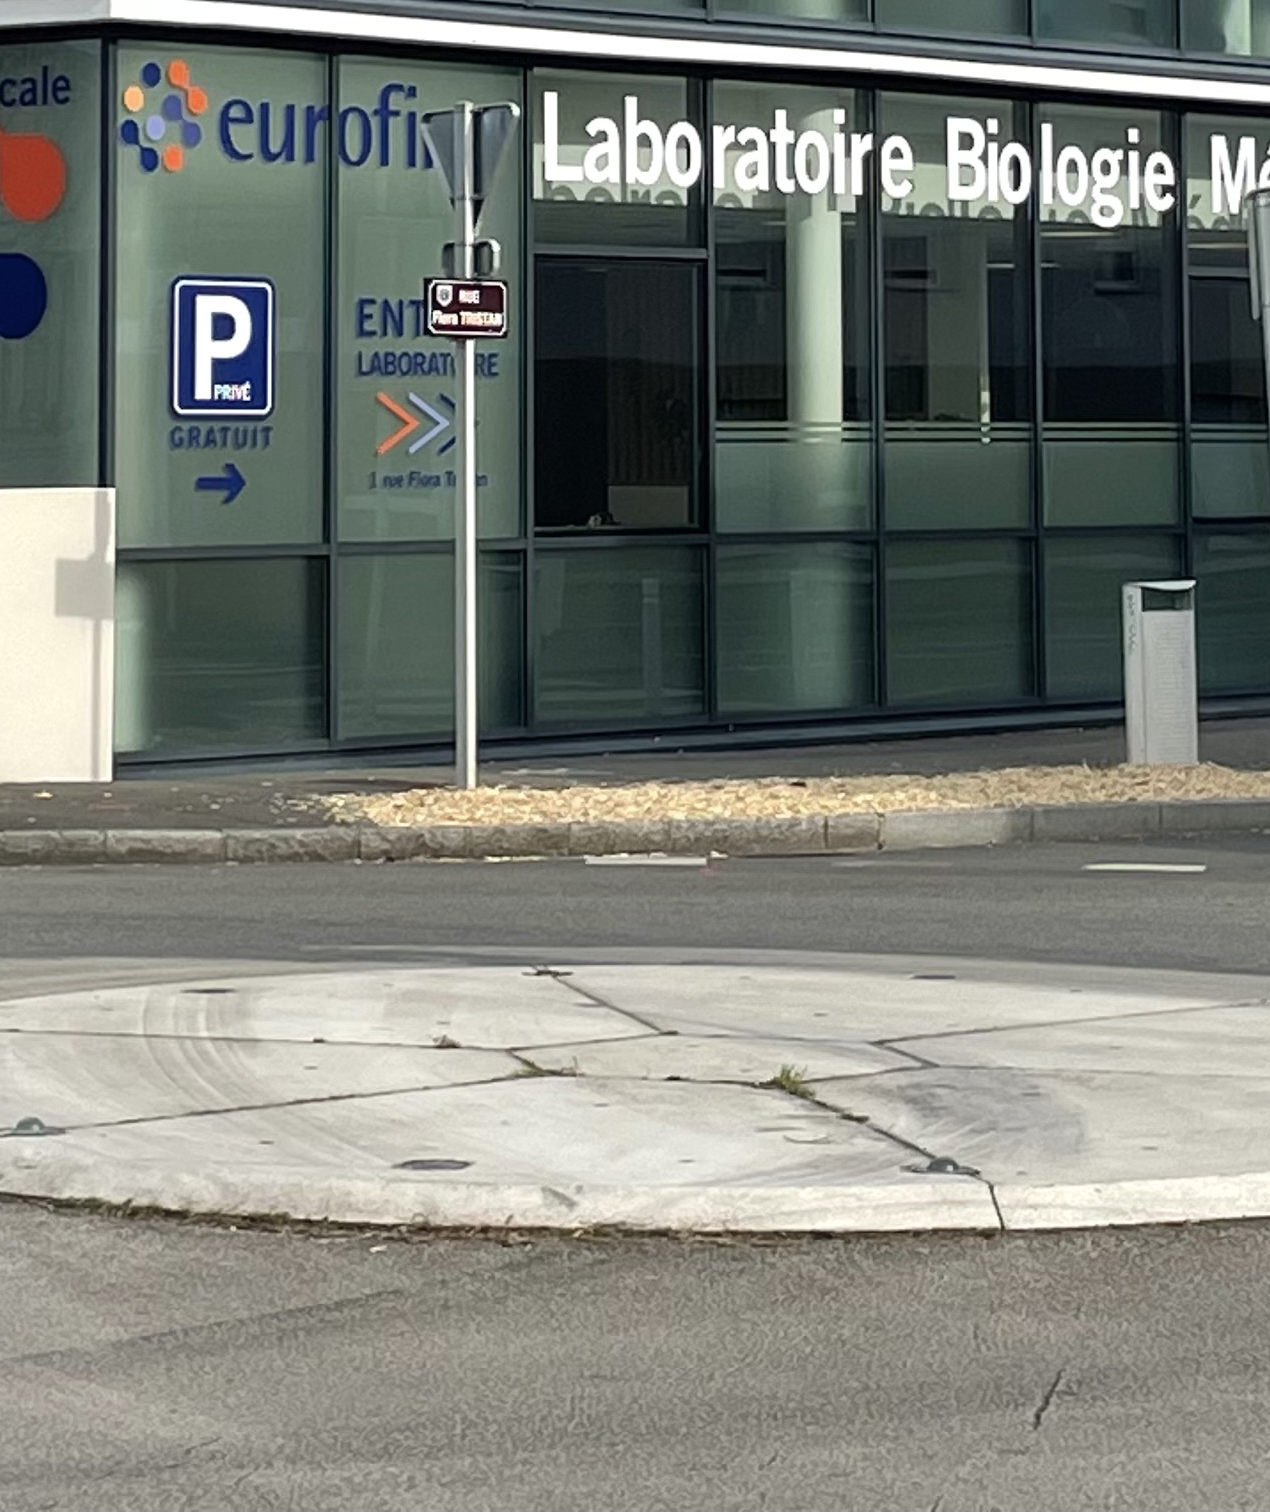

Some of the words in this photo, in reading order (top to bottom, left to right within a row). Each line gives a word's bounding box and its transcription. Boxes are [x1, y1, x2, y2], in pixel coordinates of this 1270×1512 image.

[219, 82, 438, 169] eurofi
[543, 91, 914, 199] Laboratoire
[946, 116, 1176, 228] Biologie
[357, 297, 425, 337] ENT
[194, 294, 253, 400] P
[357, 351, 500, 377] LABORATRE
[214, 381, 252, 401] PRIVÉ
[169, 425, 274, 451] GRATUIT
